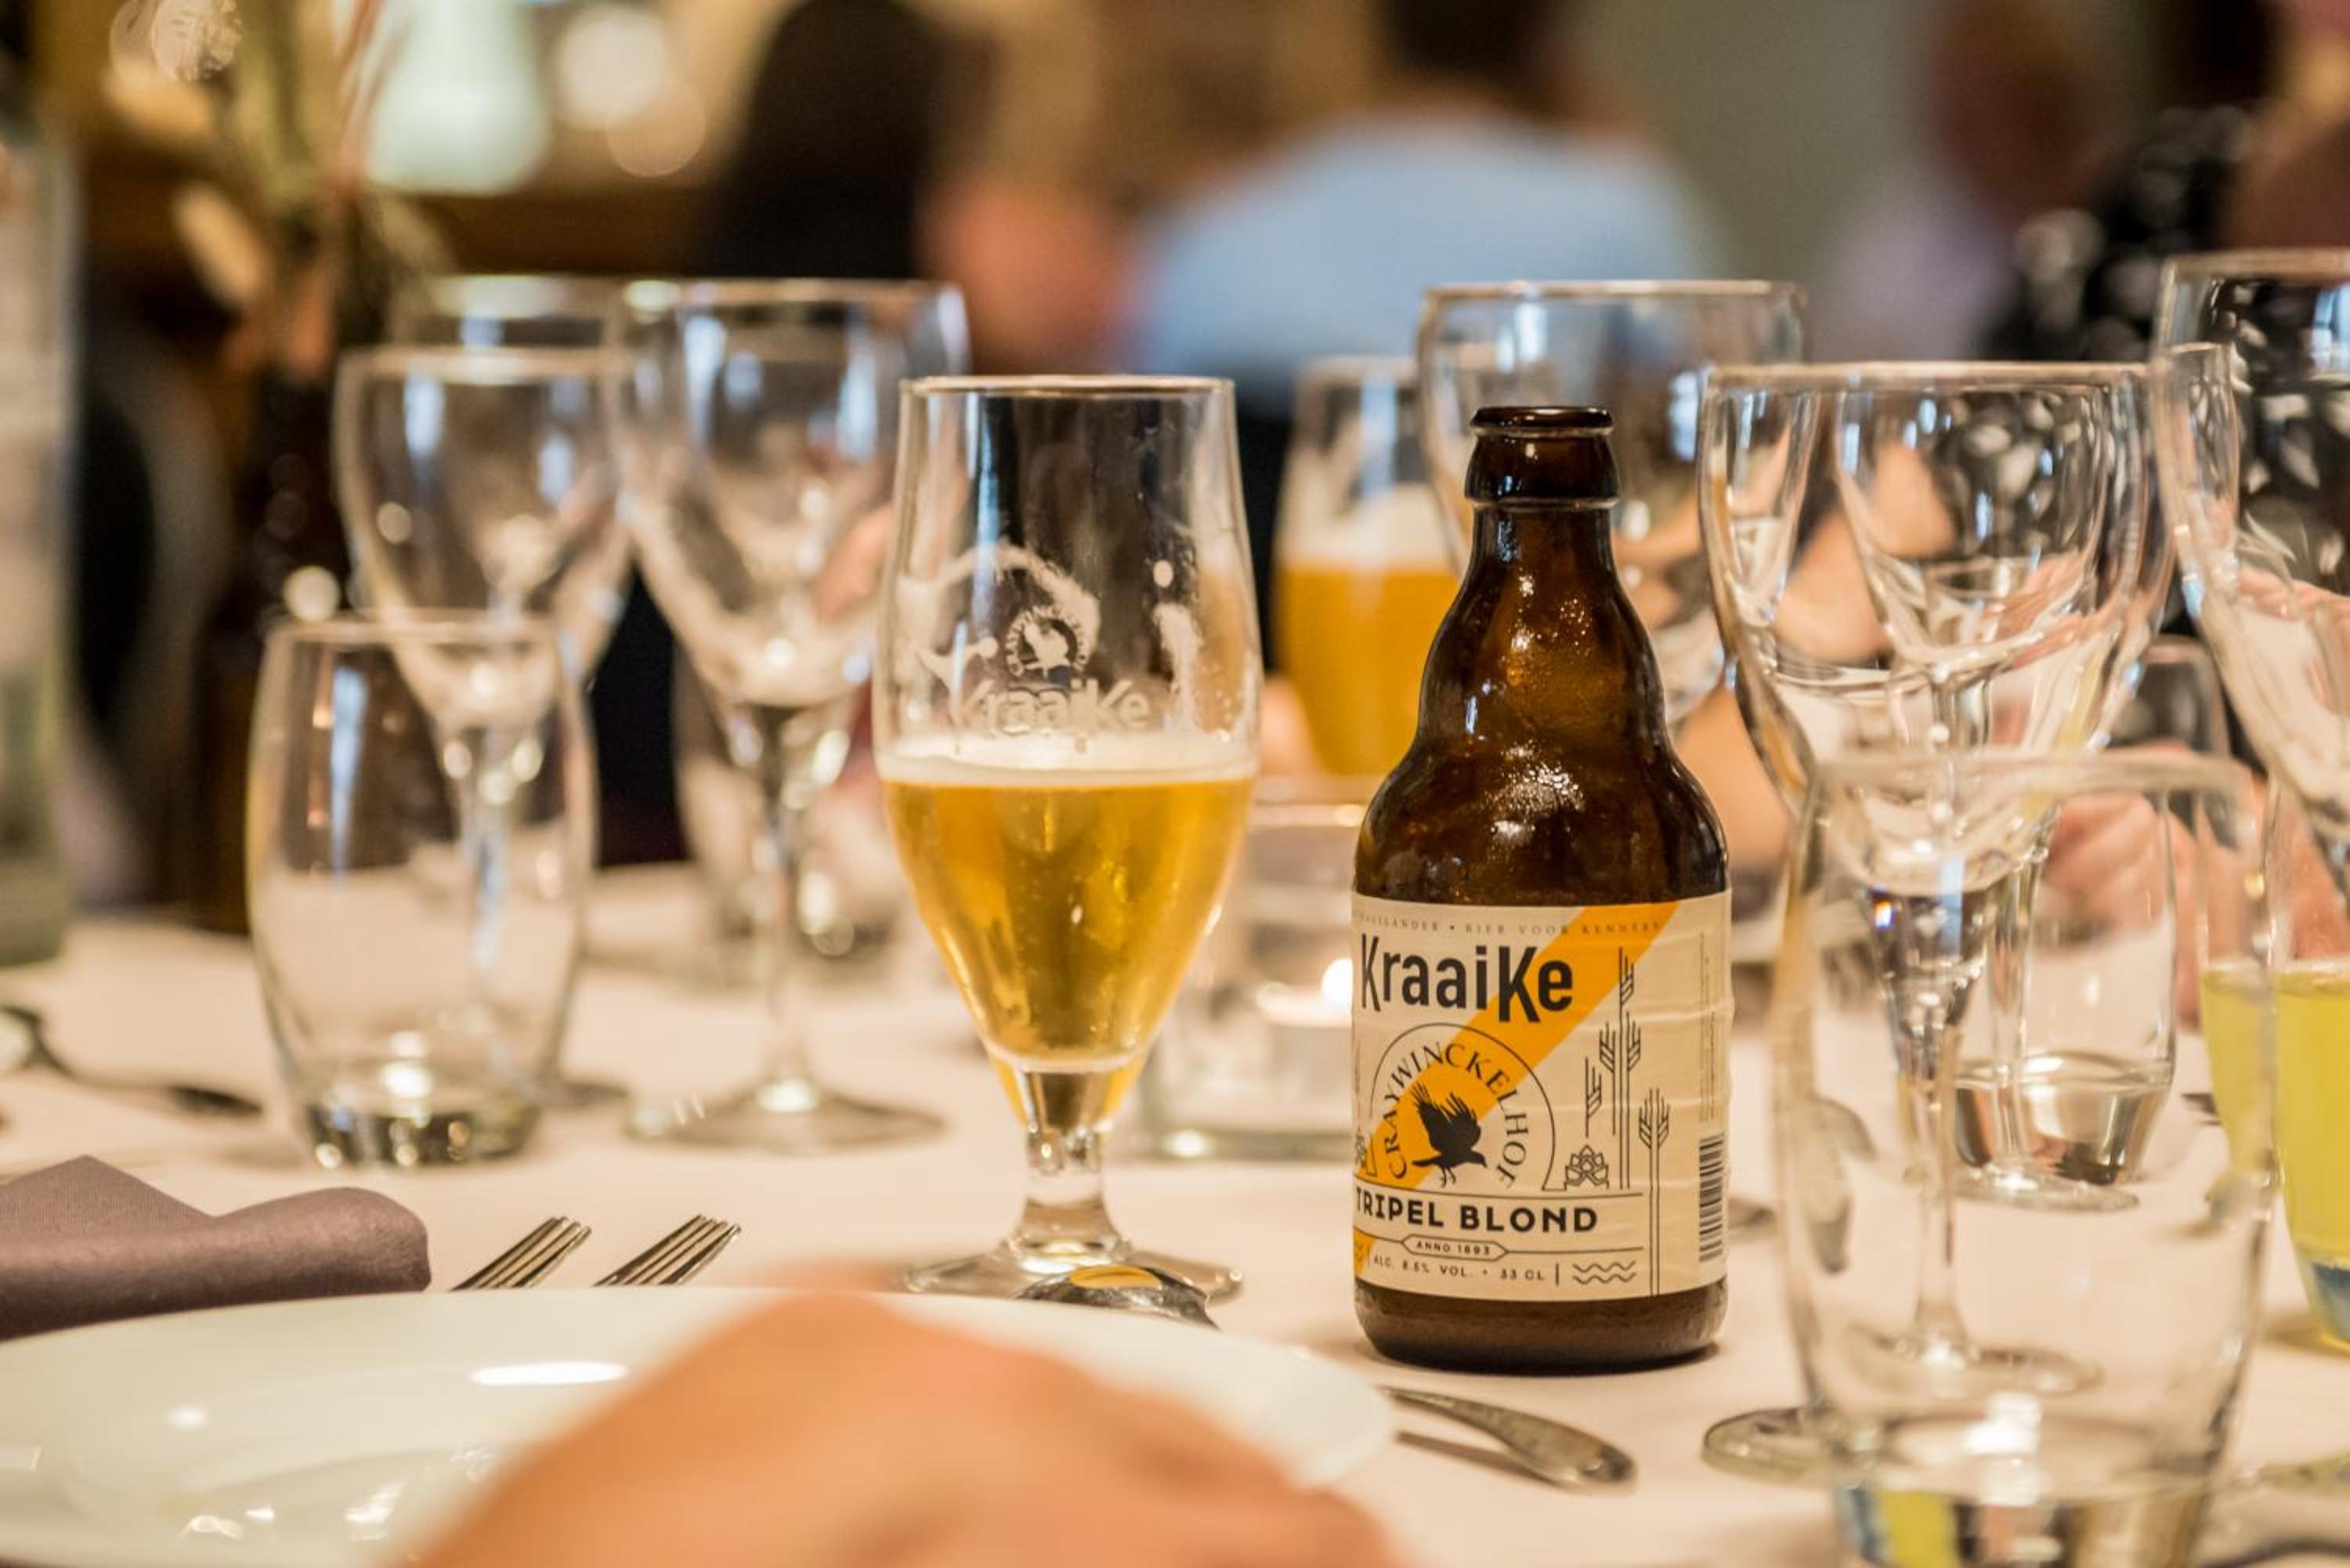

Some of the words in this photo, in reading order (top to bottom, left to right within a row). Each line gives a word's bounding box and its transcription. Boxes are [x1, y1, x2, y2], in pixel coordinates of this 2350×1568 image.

[1466, 924, 1504, 934] BIER
[1518, 925, 1567, 934] VOOR
[1361, 933, 1573, 1023] KraaiKe
[1356, 1187, 1444, 1227] TRIPEL
[1459, 1205, 1597, 1233] BLOND
[1415, 1241, 1451, 1252] ANNO
[1524, 1270, 1545, 1281] CL
